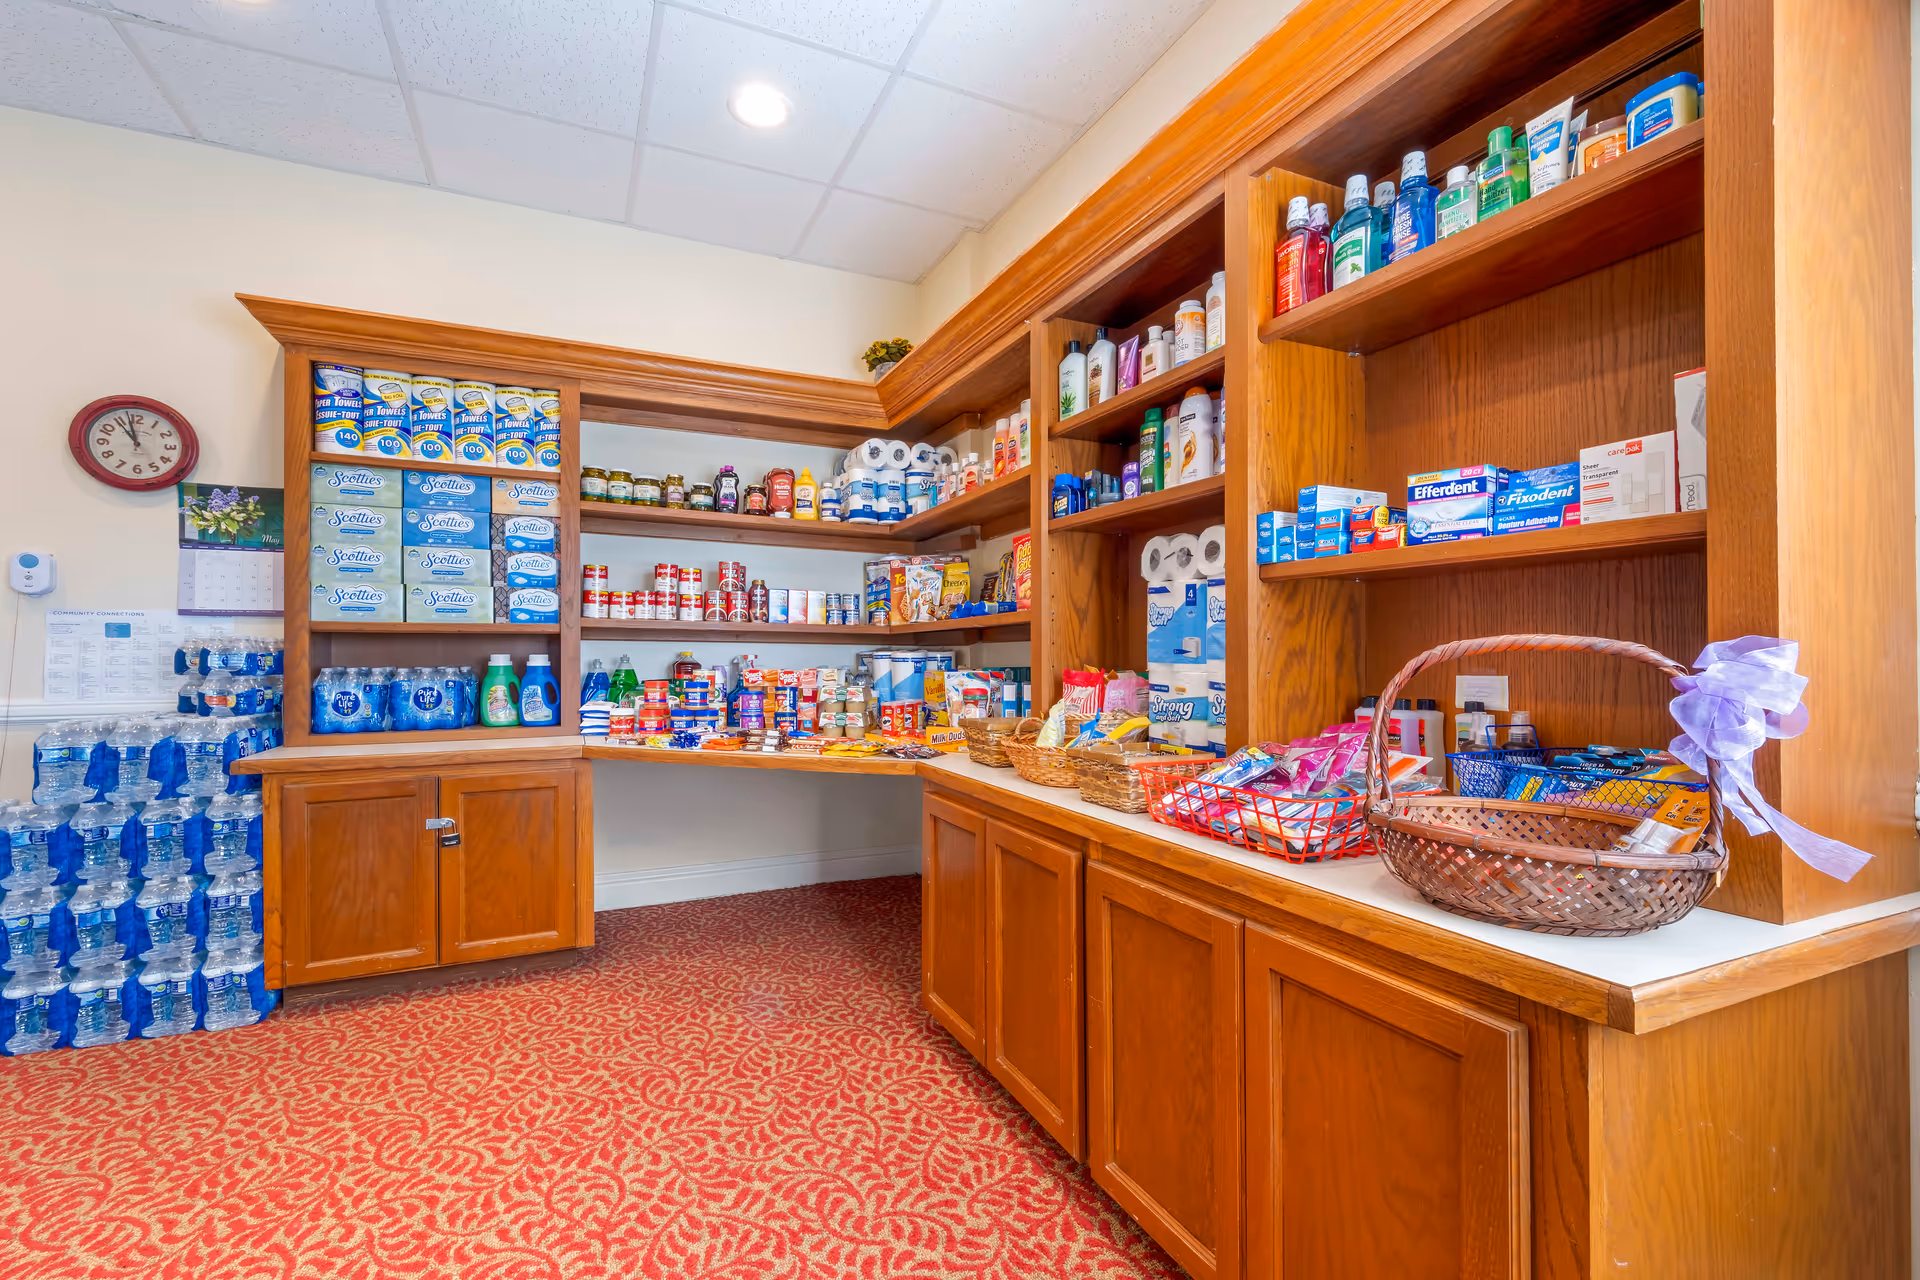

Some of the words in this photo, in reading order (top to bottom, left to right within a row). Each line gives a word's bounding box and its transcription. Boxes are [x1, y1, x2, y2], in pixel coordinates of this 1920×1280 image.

[1644, 108, 1668, 123] Petroleum
[1644, 120, 1654, 128] Jelly
[1530, 132, 1560, 151] Petroleum
[1480, 182, 1496, 196] Hand
[1480, 187, 1509, 207] Sanitizer
[1444, 208, 1460, 220] HAND
[130, 414, 144, 424] 12
[151, 420, 159, 428] 1
[99, 424, 115, 436] 10
[160, 430, 172, 439] 2
[96, 438, 110, 446] 9
[339, 432, 358, 441] 140
[380, 439, 400, 448] 100
[423, 443, 441, 451] 100
[102, 450, 114, 458] 8
[160, 456, 172, 464] 4
[508, 450, 526, 458] 100
[542, 452, 560, 460] 100
[115, 460, 127, 468] 7
[132, 464, 142, 474] 6
[148, 462, 160, 472] 5
[328, 471, 382, 487] Scotties
[1583, 470, 1618, 480] Transparent
[421, 476, 471, 494] Scotties
[508, 483, 555, 498] Scotties
[1414, 480, 1479, 500] Efferdent
[1507, 485, 1574, 506] Fixodent
[328, 510, 382, 526] Scotties
[420, 514, 470, 531] Scotties
[1498, 520, 1524, 530] Denture
[1526, 516, 1558, 526] Adhesive
[508, 521, 548, 534] Scotties
[262, 534, 280, 545] May
[327, 548, 381, 566] Scotties
[420, 552, 470, 568] Scotties
[510, 558, 550, 571] Scotties
[944, 580, 968, 588] Cheerios
[328, 588, 382, 604] Scotties
[424, 590, 474, 606] Scotties
[512, 594, 552, 606] Scotties
[1188, 590, 1194, 598] 4
[1150, 603, 1174, 620] Strong
[338, 700, 354, 709] Life
[420, 696, 436, 704] Life
[1152, 695, 1194, 720] Strong
[1156, 714, 1166, 723] and
[1167, 712, 1180, 722] Soft
[931, 734, 946, 744] Milk
[948, 730, 966, 742] Duds
